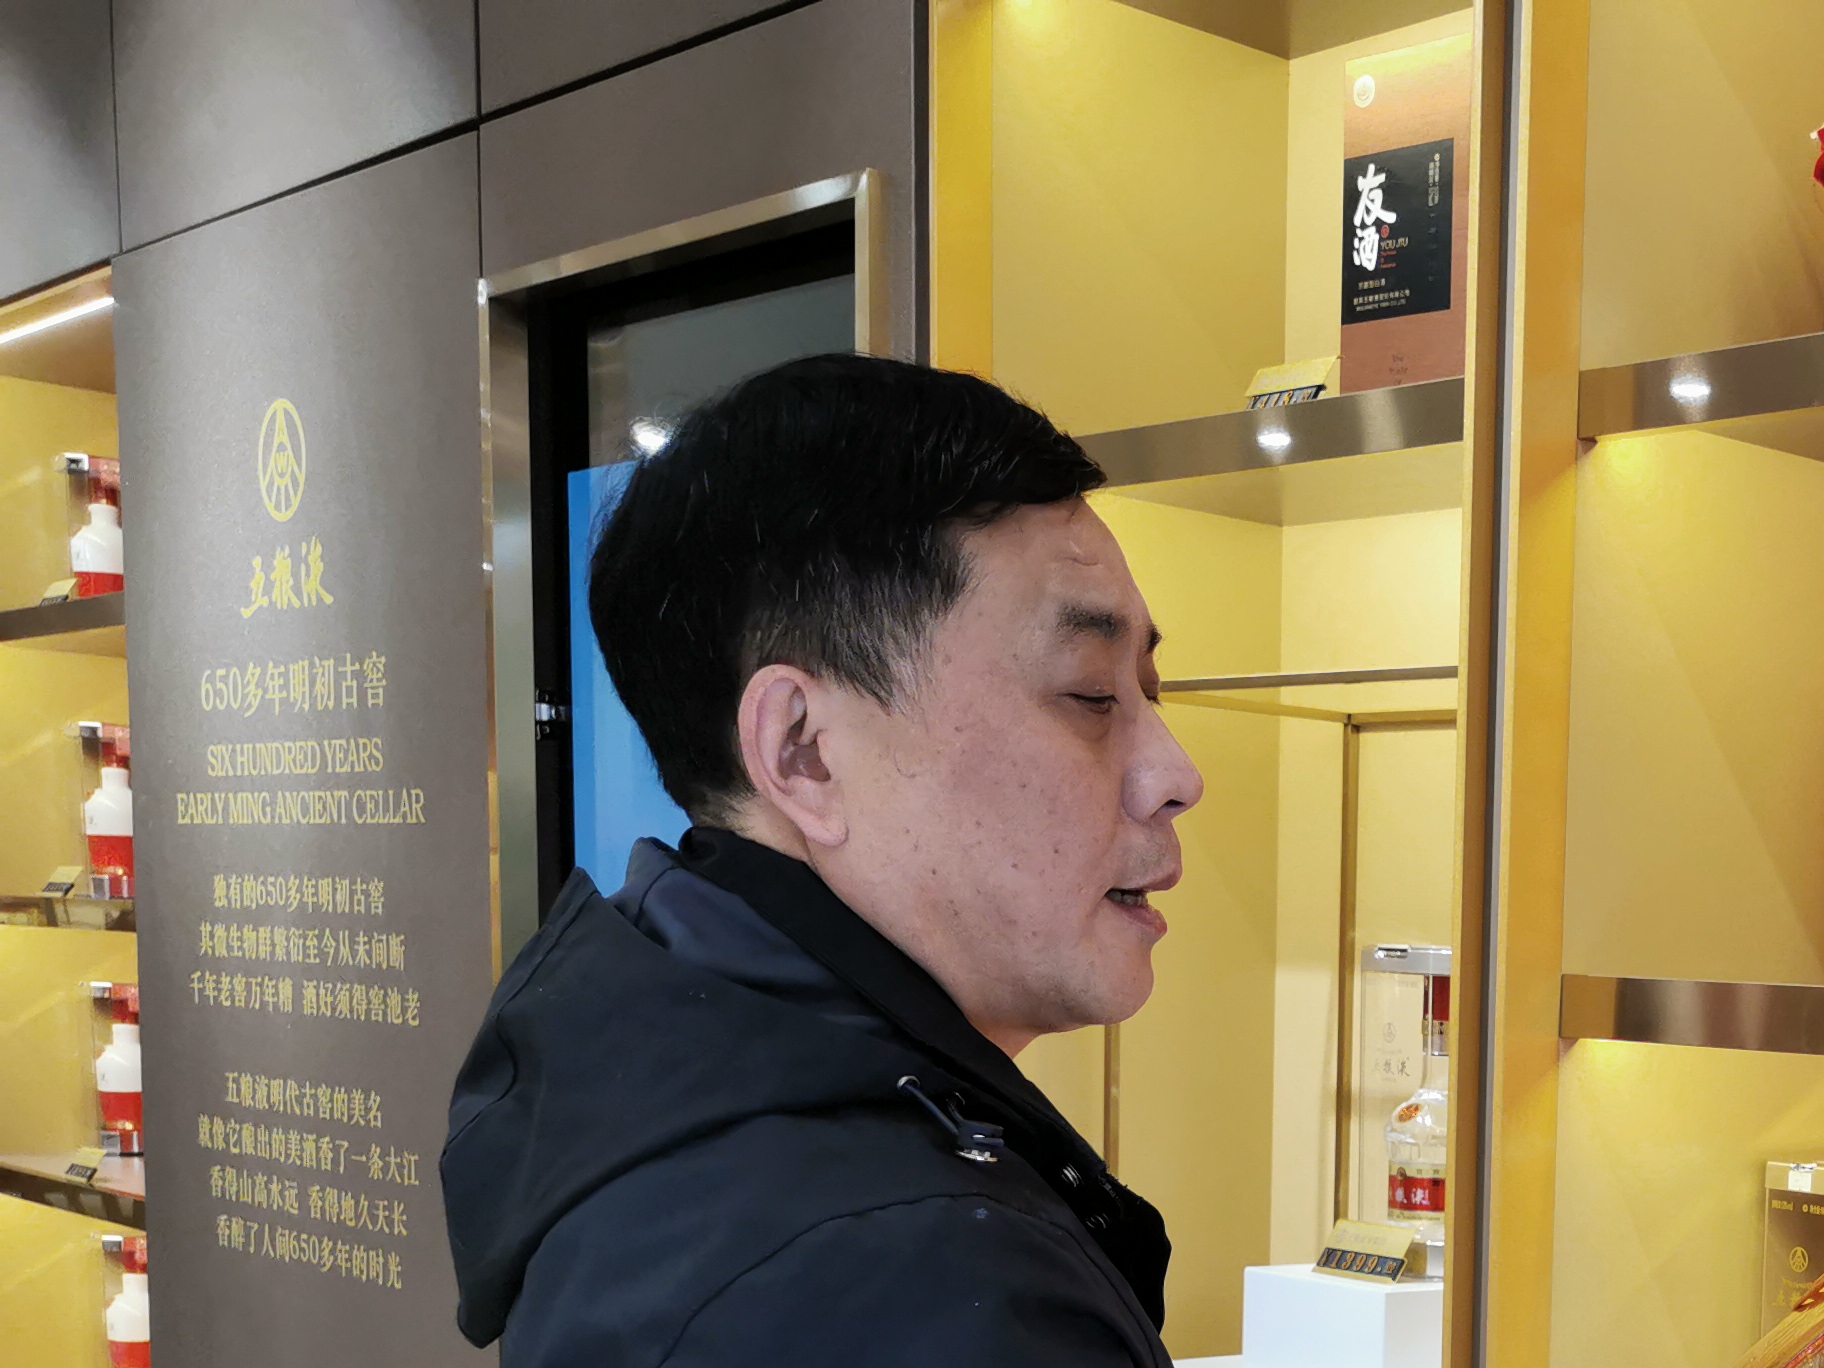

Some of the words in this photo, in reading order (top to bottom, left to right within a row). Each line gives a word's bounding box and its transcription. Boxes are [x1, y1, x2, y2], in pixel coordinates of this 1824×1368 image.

[1353, 163, 1397, 272] 友酒
[241, 535, 334, 619] 五粮液
[201, 651, 388, 718] 650多年明初古窖
[207, 745, 233, 777] SIX
[236, 740, 321, 777] HUNDRED
[324, 737, 384, 774] YEARS
[177, 792, 224, 824] EARLY
[229, 791, 271, 825] MING
[275, 790, 349, 825] ANCIENT
[353, 787, 426, 825] CELLAR
[213, 873, 386, 916] 独有的650多年明初古窖
[199, 919, 406, 972] 其微生物群繁衍至今从未间断
[189, 970, 294, 1015] 千年老窖万年糟
[302, 978, 421, 1027] 酒好须得窖池老
[224, 1070, 382, 1129] 五粮液明代古窖的美名
[197, 1112, 420, 1187] 就像它酿出的美酒香了一条大江
[210, 1164, 299, 1216] 香得山高水远
[308, 1184, 408, 1237] 香得地久天长
[216, 1213, 402, 1290] 香醉了人间650多年的时光
